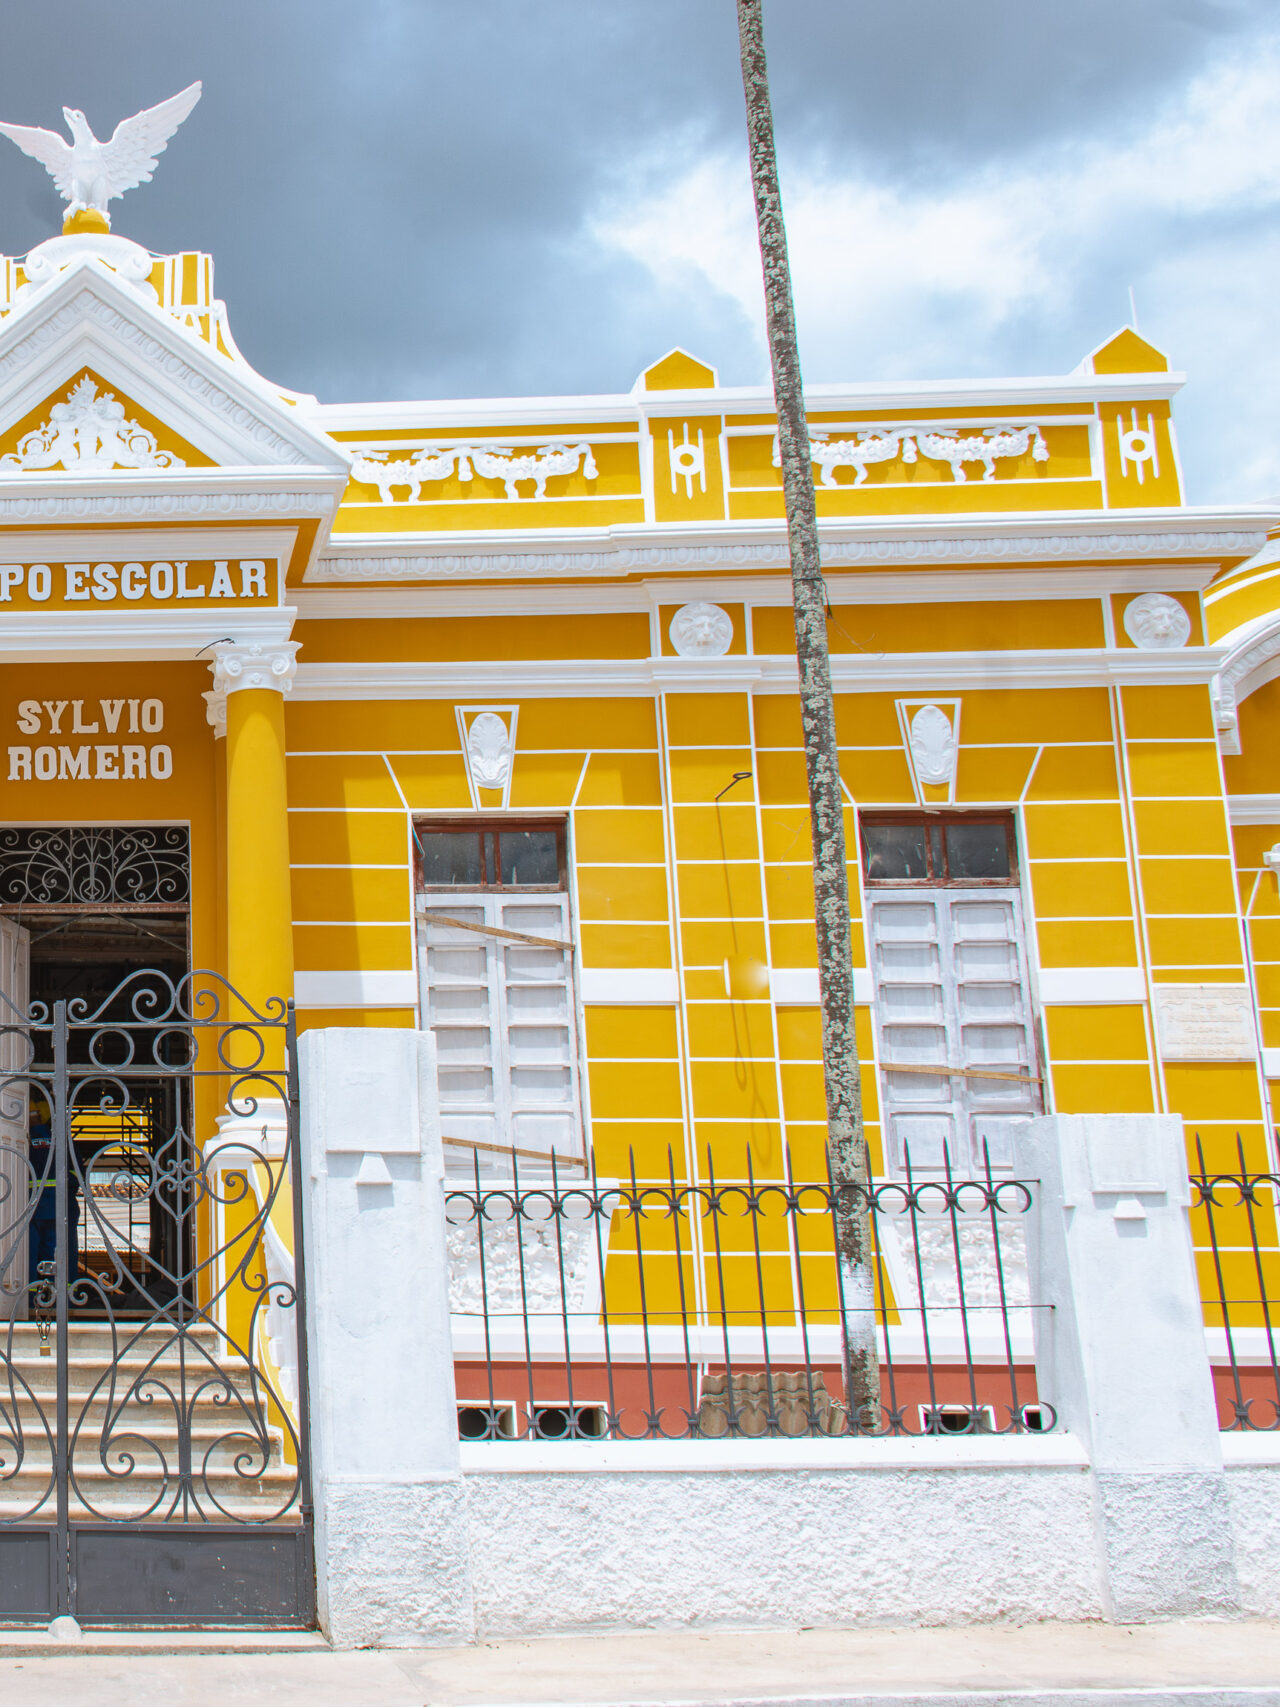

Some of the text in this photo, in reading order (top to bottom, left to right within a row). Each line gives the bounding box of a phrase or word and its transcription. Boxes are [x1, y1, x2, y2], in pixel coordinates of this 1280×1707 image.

[63, 560, 269, 601] ESCOLAR
[16, 698, 164, 735] SYLVIO
[7, 744, 173, 781] ROMERO
